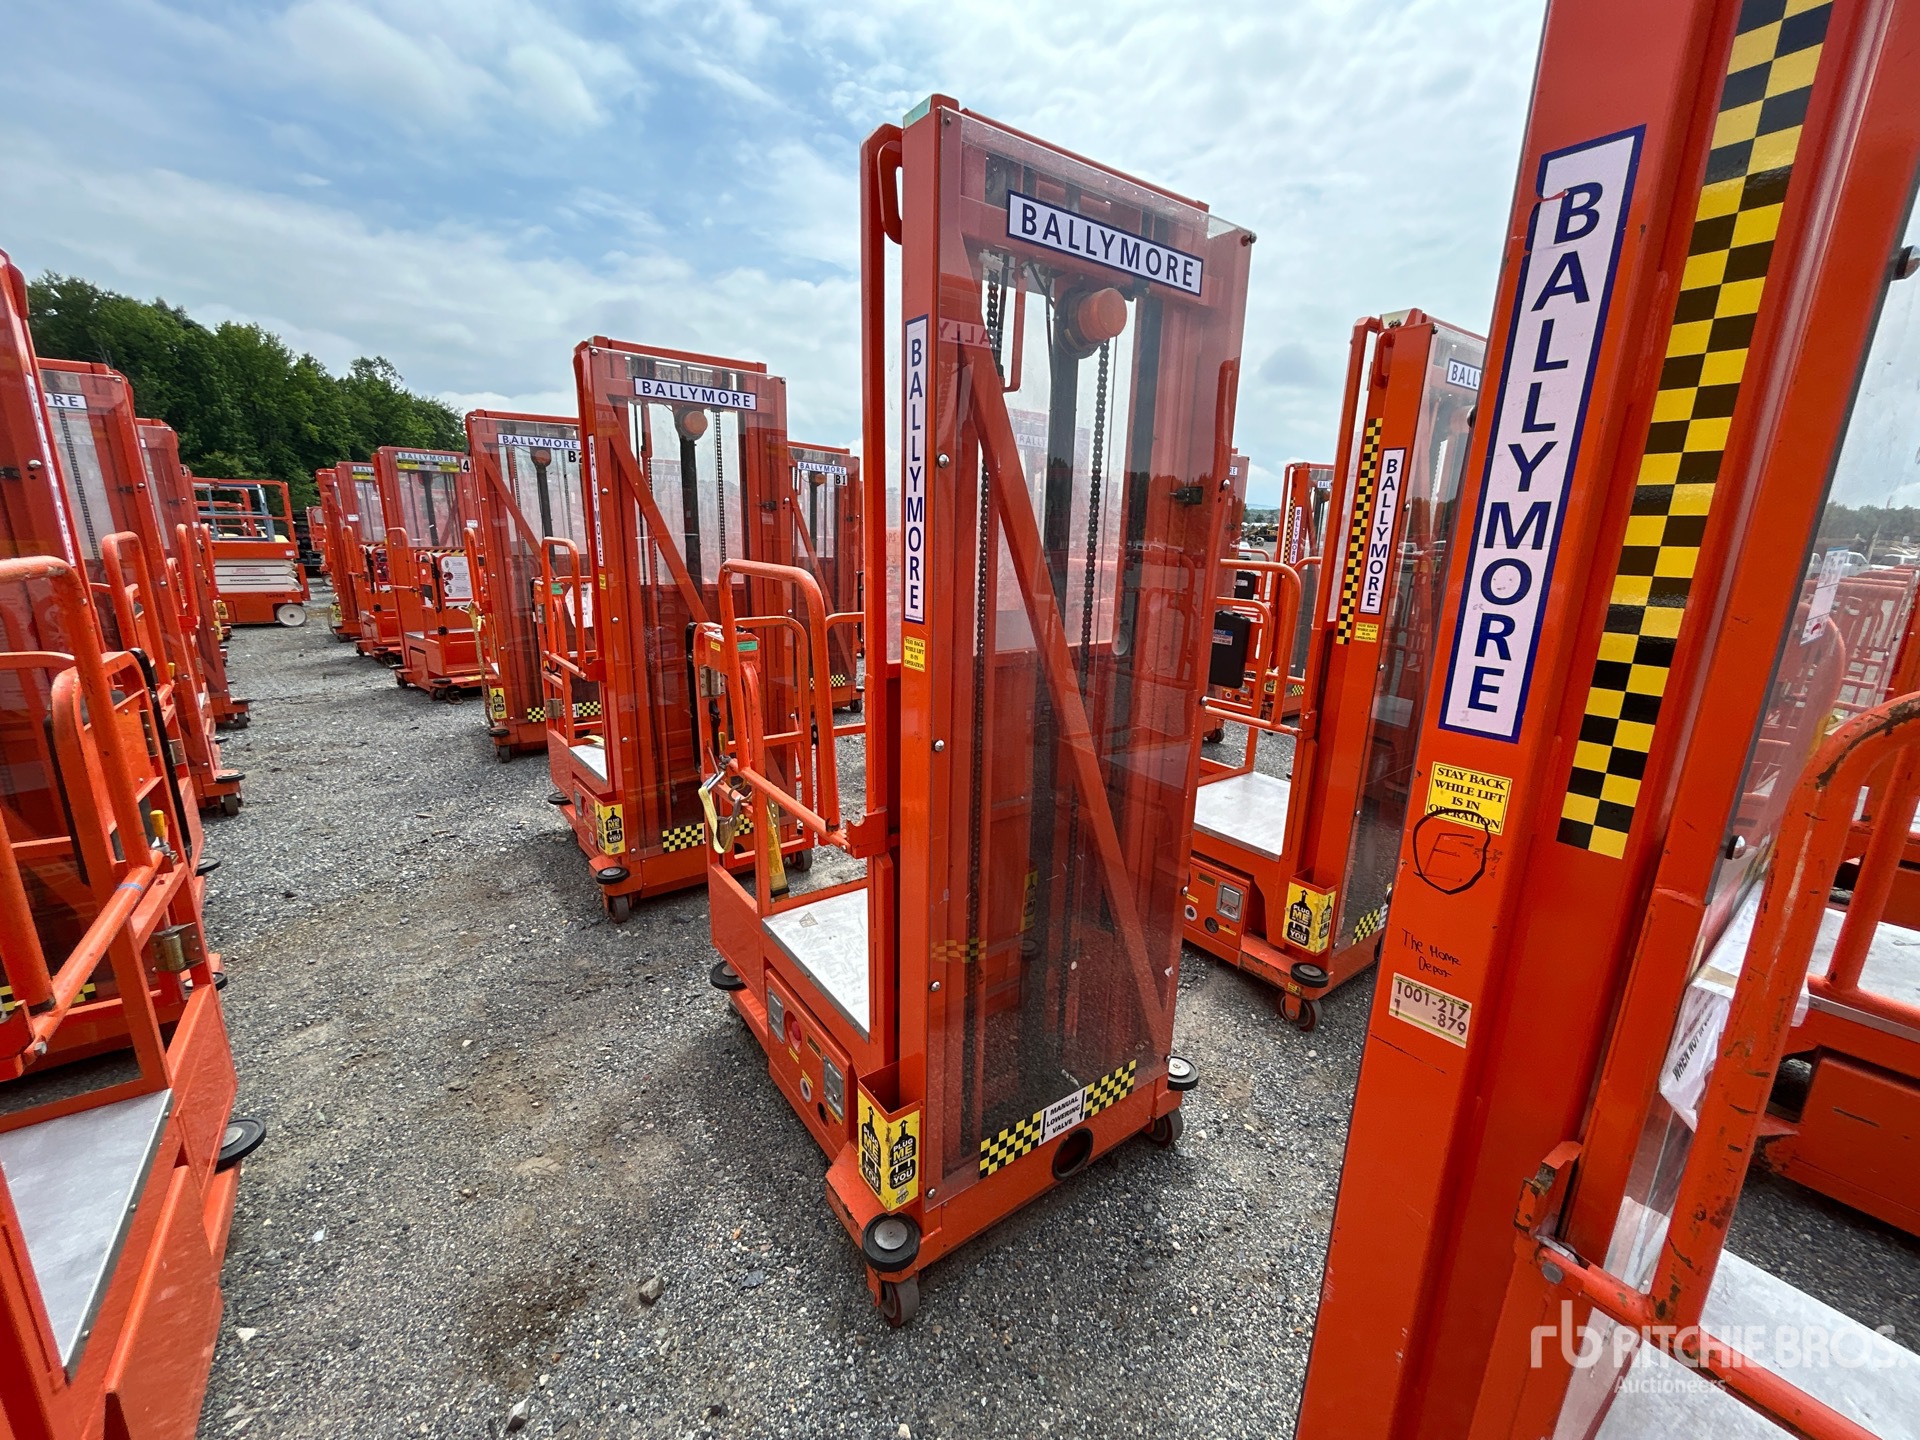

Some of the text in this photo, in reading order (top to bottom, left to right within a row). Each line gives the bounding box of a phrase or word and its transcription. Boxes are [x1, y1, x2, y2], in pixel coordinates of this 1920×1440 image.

[1021, 202, 1194, 288] BALLYMORE
[641, 380, 751, 408] BALLYMORE
[502, 435, 577, 448] BALLYMORE
[1468, 181, 1604, 713] BALLYMORE
[401, 452, 454, 463] BALLYMORE
[462, 460, 470, 473] 4
[800, 462, 845, 473] BALLYMORE
[907, 338, 923, 610] BALLYMORE
[835, 474, 846, 485] B1
[1290, 509, 1301, 562] BALLYMORE
[1366, 458, 1398, 607] BALLYMORE
[1437, 767, 1506, 790] STAY BACK
[1435, 779, 1505, 803] WHILE LIFT
[1451, 796, 1480, 811] IS IN
[1292, 910, 1310, 922] ME
[1293, 904, 1310, 915] PLUG
[1290, 930, 1307, 942] YOU
[1402, 928, 1423, 953] The
[1397, 981, 1467, 1019] 1001-217
[1672, 1051, 1691, 1082] WHEN
[1050, 1096, 1079, 1115] MANUAL
[1046, 1104, 1080, 1127] LOWERING
[1052, 1118, 1073, 1134] VALVE
[863, 1125, 879, 1147] PLUG
[893, 1138, 913, 1152] PLUG
[893, 1143, 913, 1161] ME
[893, 1169, 913, 1184] YOU
